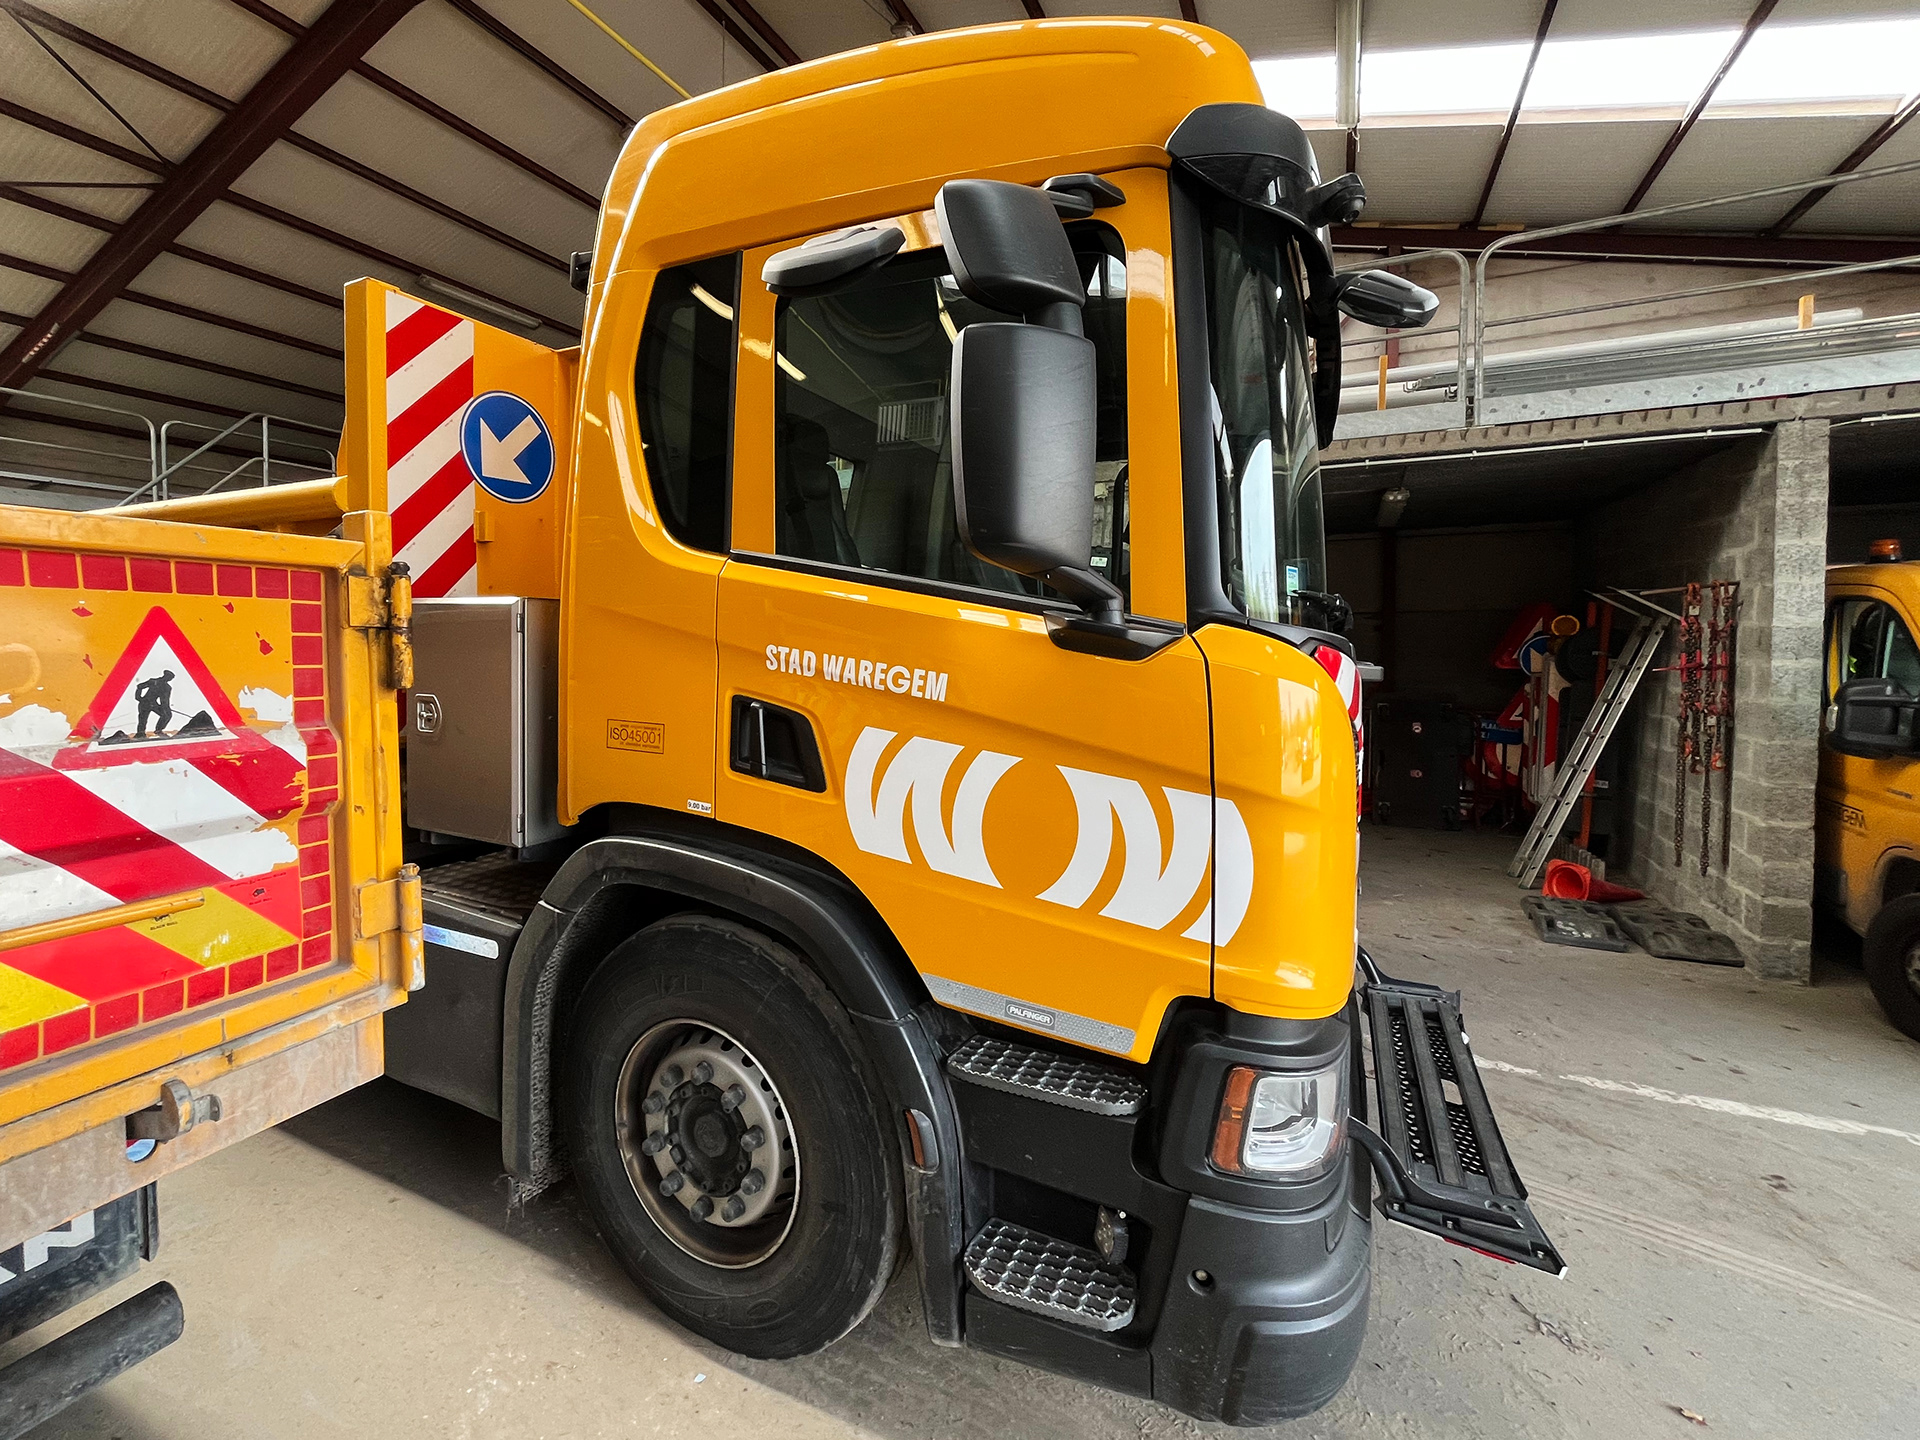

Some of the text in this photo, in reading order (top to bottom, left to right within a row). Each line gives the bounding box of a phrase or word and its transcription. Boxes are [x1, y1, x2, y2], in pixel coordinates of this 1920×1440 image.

[765, 644, 949, 702] STAD WAREGEM
[609, 727, 661, 744] ISO45001
[1009, 1006, 1051, 1024] PALFINGER
